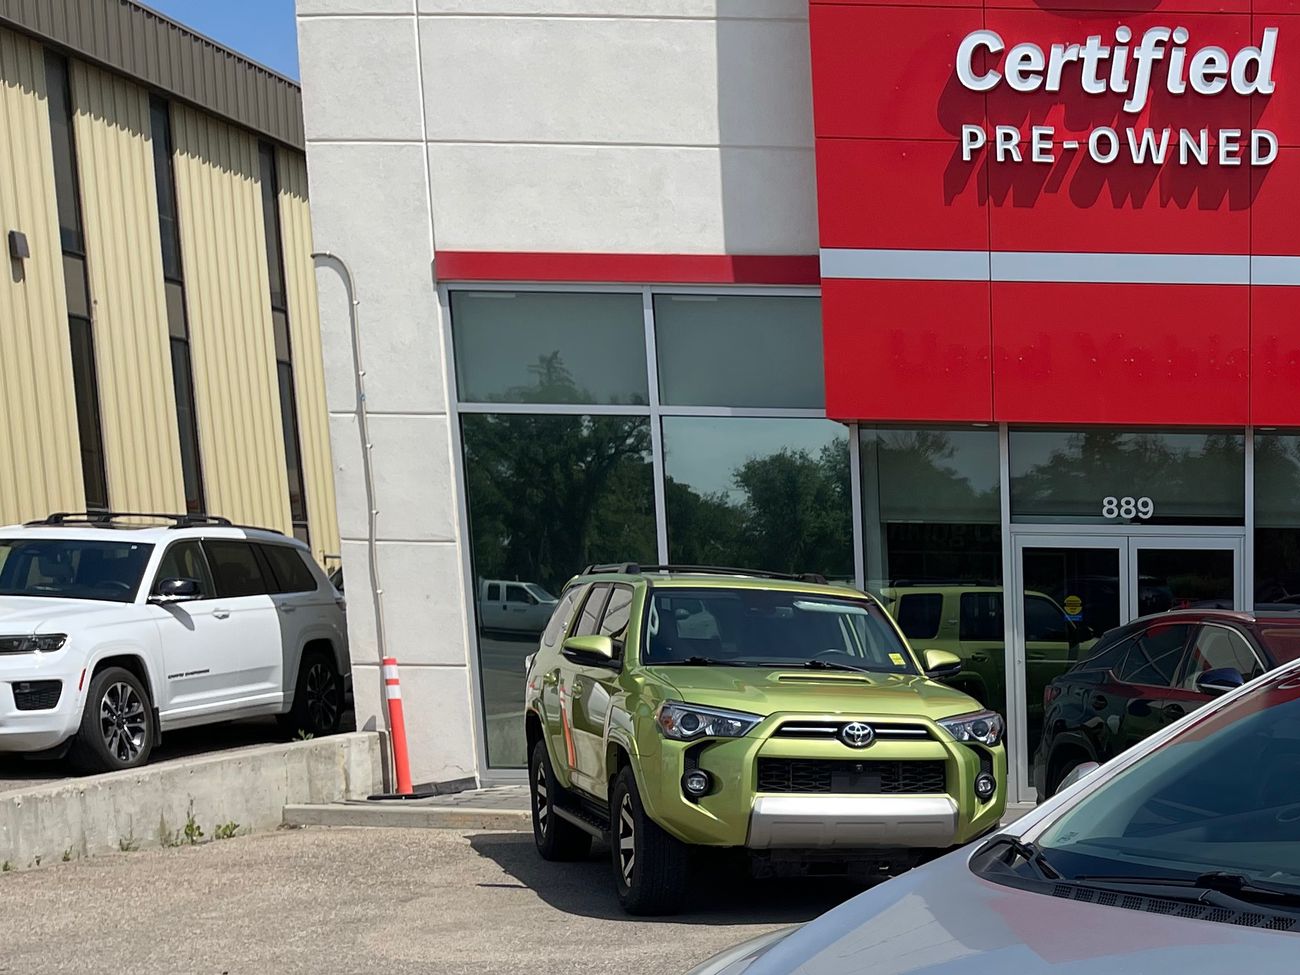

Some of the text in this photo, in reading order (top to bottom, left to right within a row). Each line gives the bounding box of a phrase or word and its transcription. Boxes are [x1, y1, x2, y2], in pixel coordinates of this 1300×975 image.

[956, 26, 1279, 113] Certified
[961, 124, 1279, 166] PRE-OWNED
[1102, 496, 1154, 519] 889
